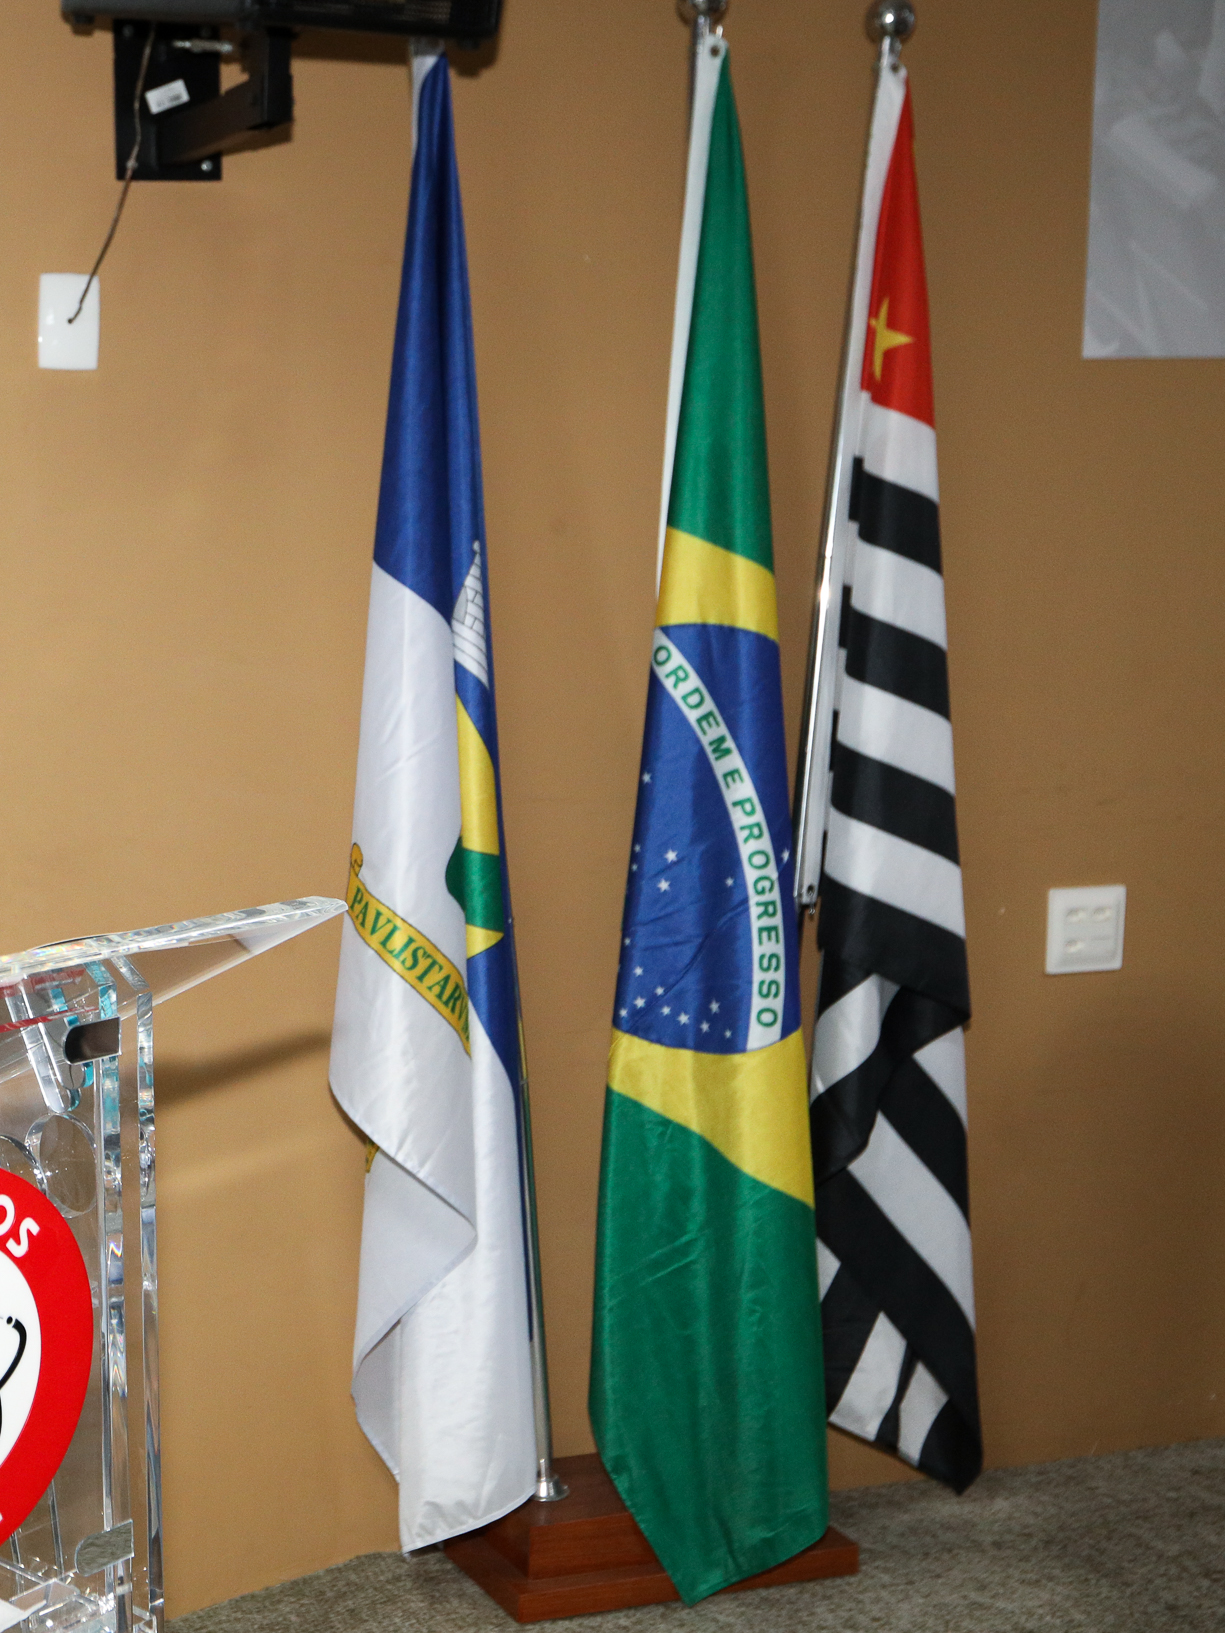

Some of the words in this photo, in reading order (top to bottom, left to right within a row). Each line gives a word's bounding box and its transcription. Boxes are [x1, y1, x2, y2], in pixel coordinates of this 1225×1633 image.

[653, 645, 733, 762] ORDEM
[722, 768, 744, 789] E
[732, 797, 781, 1028] PROGRESSO
